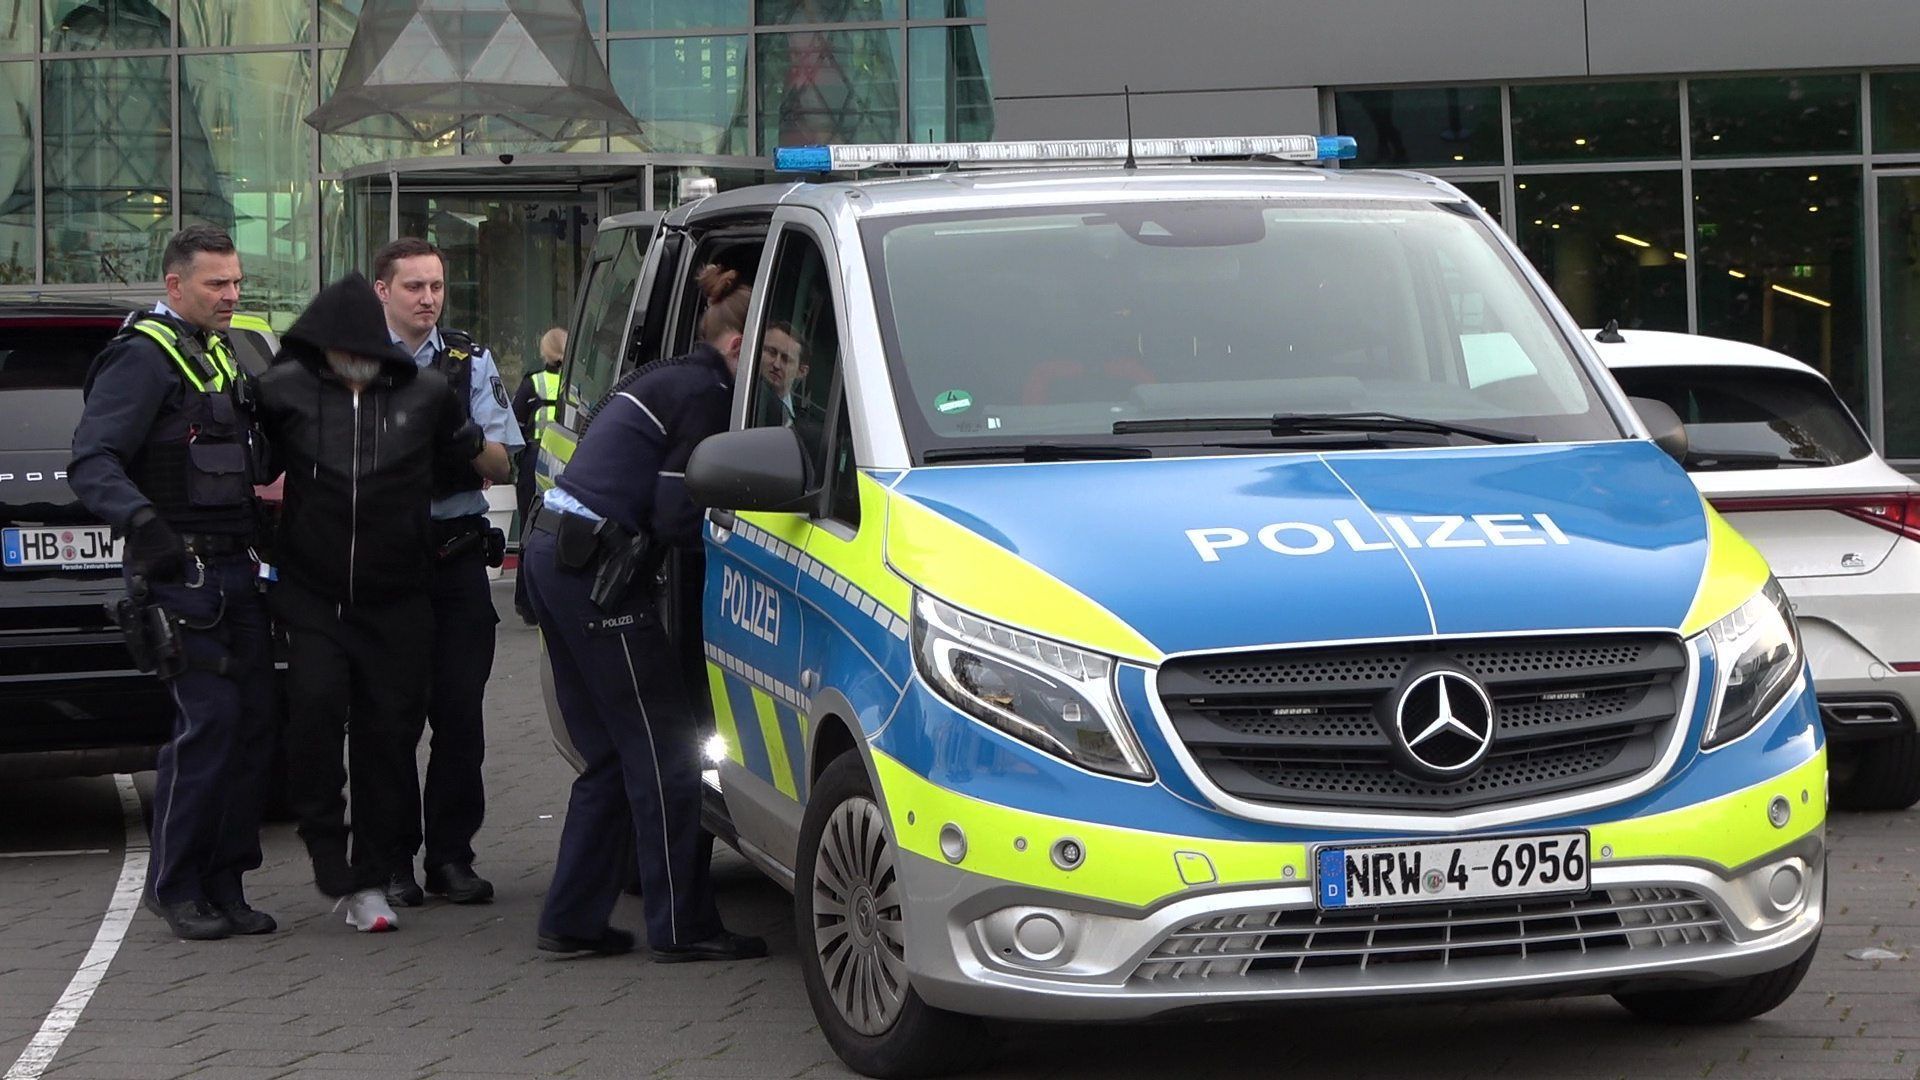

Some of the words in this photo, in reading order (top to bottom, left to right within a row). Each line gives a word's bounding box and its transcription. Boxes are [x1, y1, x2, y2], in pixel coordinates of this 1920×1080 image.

[22, 533, 59, 560] HB
[80, 532, 114, 558] JW
[1185, 513, 1571, 562] POLIZEI
[9, 551, 16, 559] D
[721, 564, 780, 646] POLIZEI
[602, 615, 634, 628] POLIZEI
[1345, 851, 1421, 897] NRW
[1328, 884, 1338, 897] D
